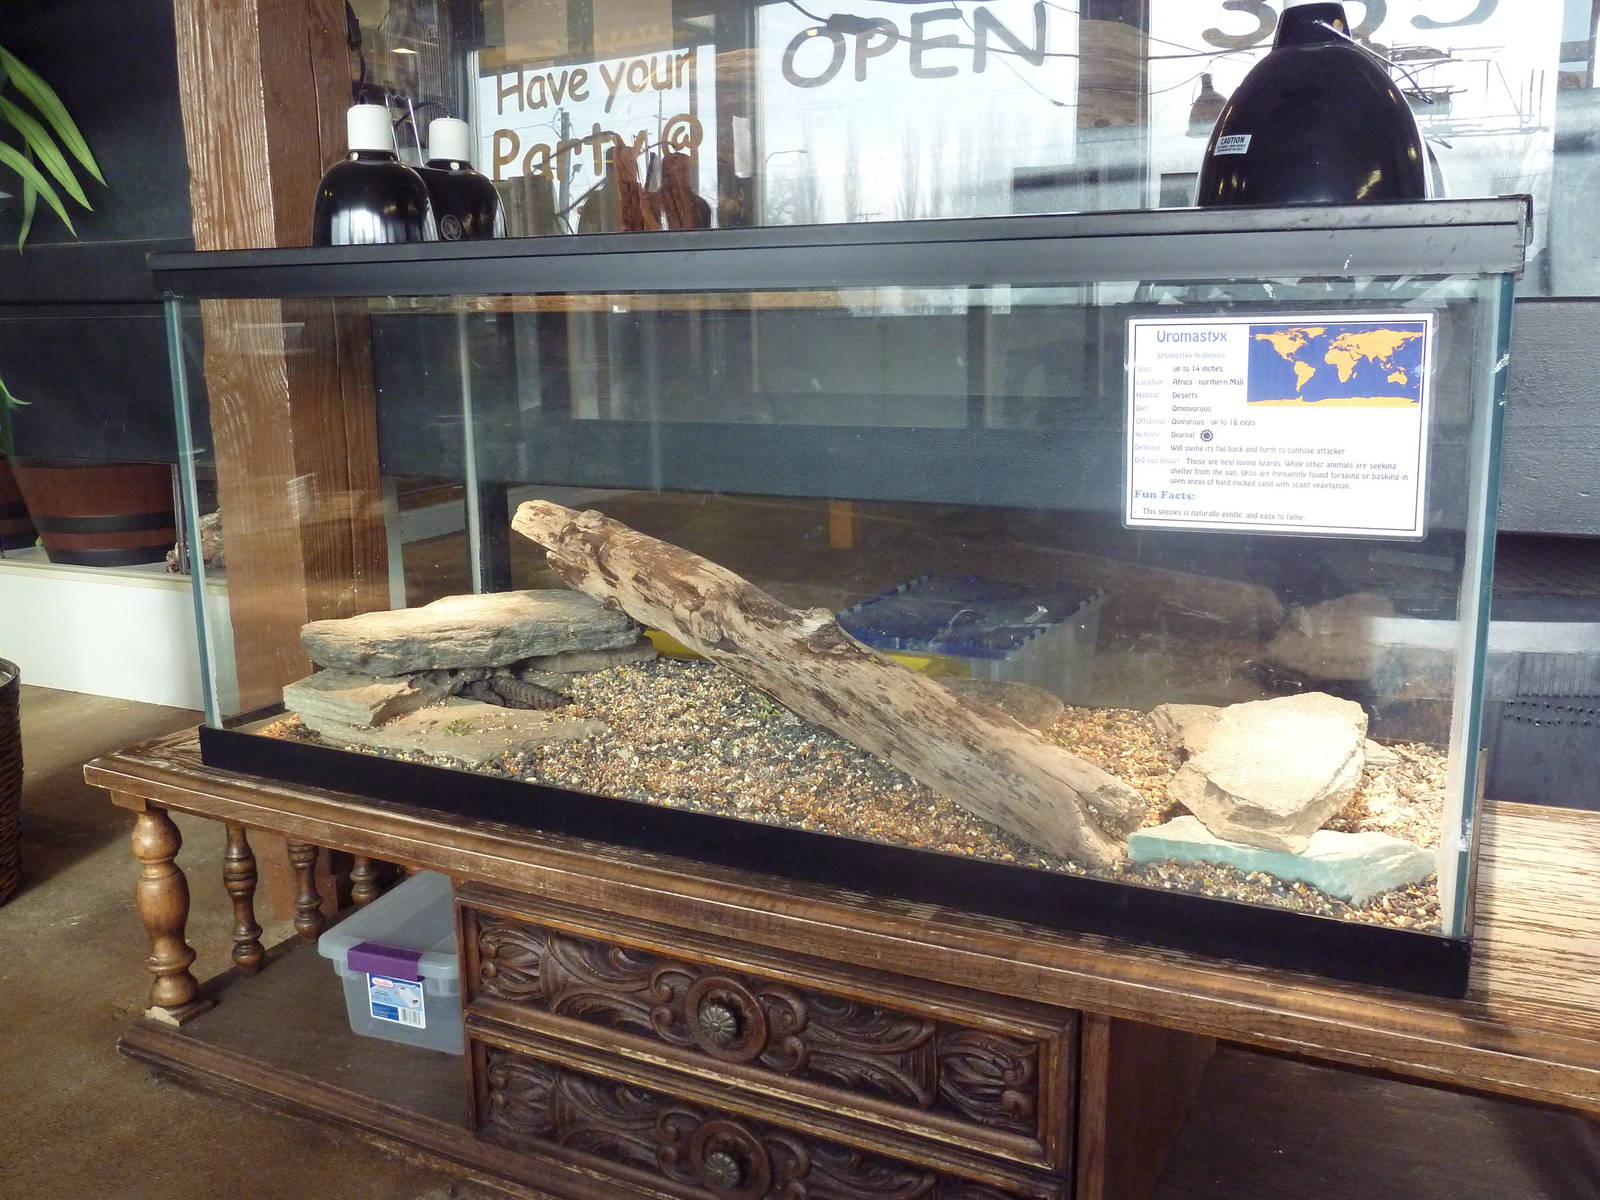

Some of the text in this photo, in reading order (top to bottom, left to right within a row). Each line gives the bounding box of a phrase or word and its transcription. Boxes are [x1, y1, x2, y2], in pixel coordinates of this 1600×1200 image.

[782, 2, 1046, 88] OPEN
[496, 49, 691, 115] Have your
[1157, 330, 1227, 342] Uromastyx
[1370, 462, 1396, 470] seeking
[1331, 472, 1360, 480] foraging
[1232, 479, 1256, 487] packed
[1135, 490, 1196, 500] Fun Facts:
[1191, 510, 1220, 518] naturally
[1278, 512, 1285, 520] to
